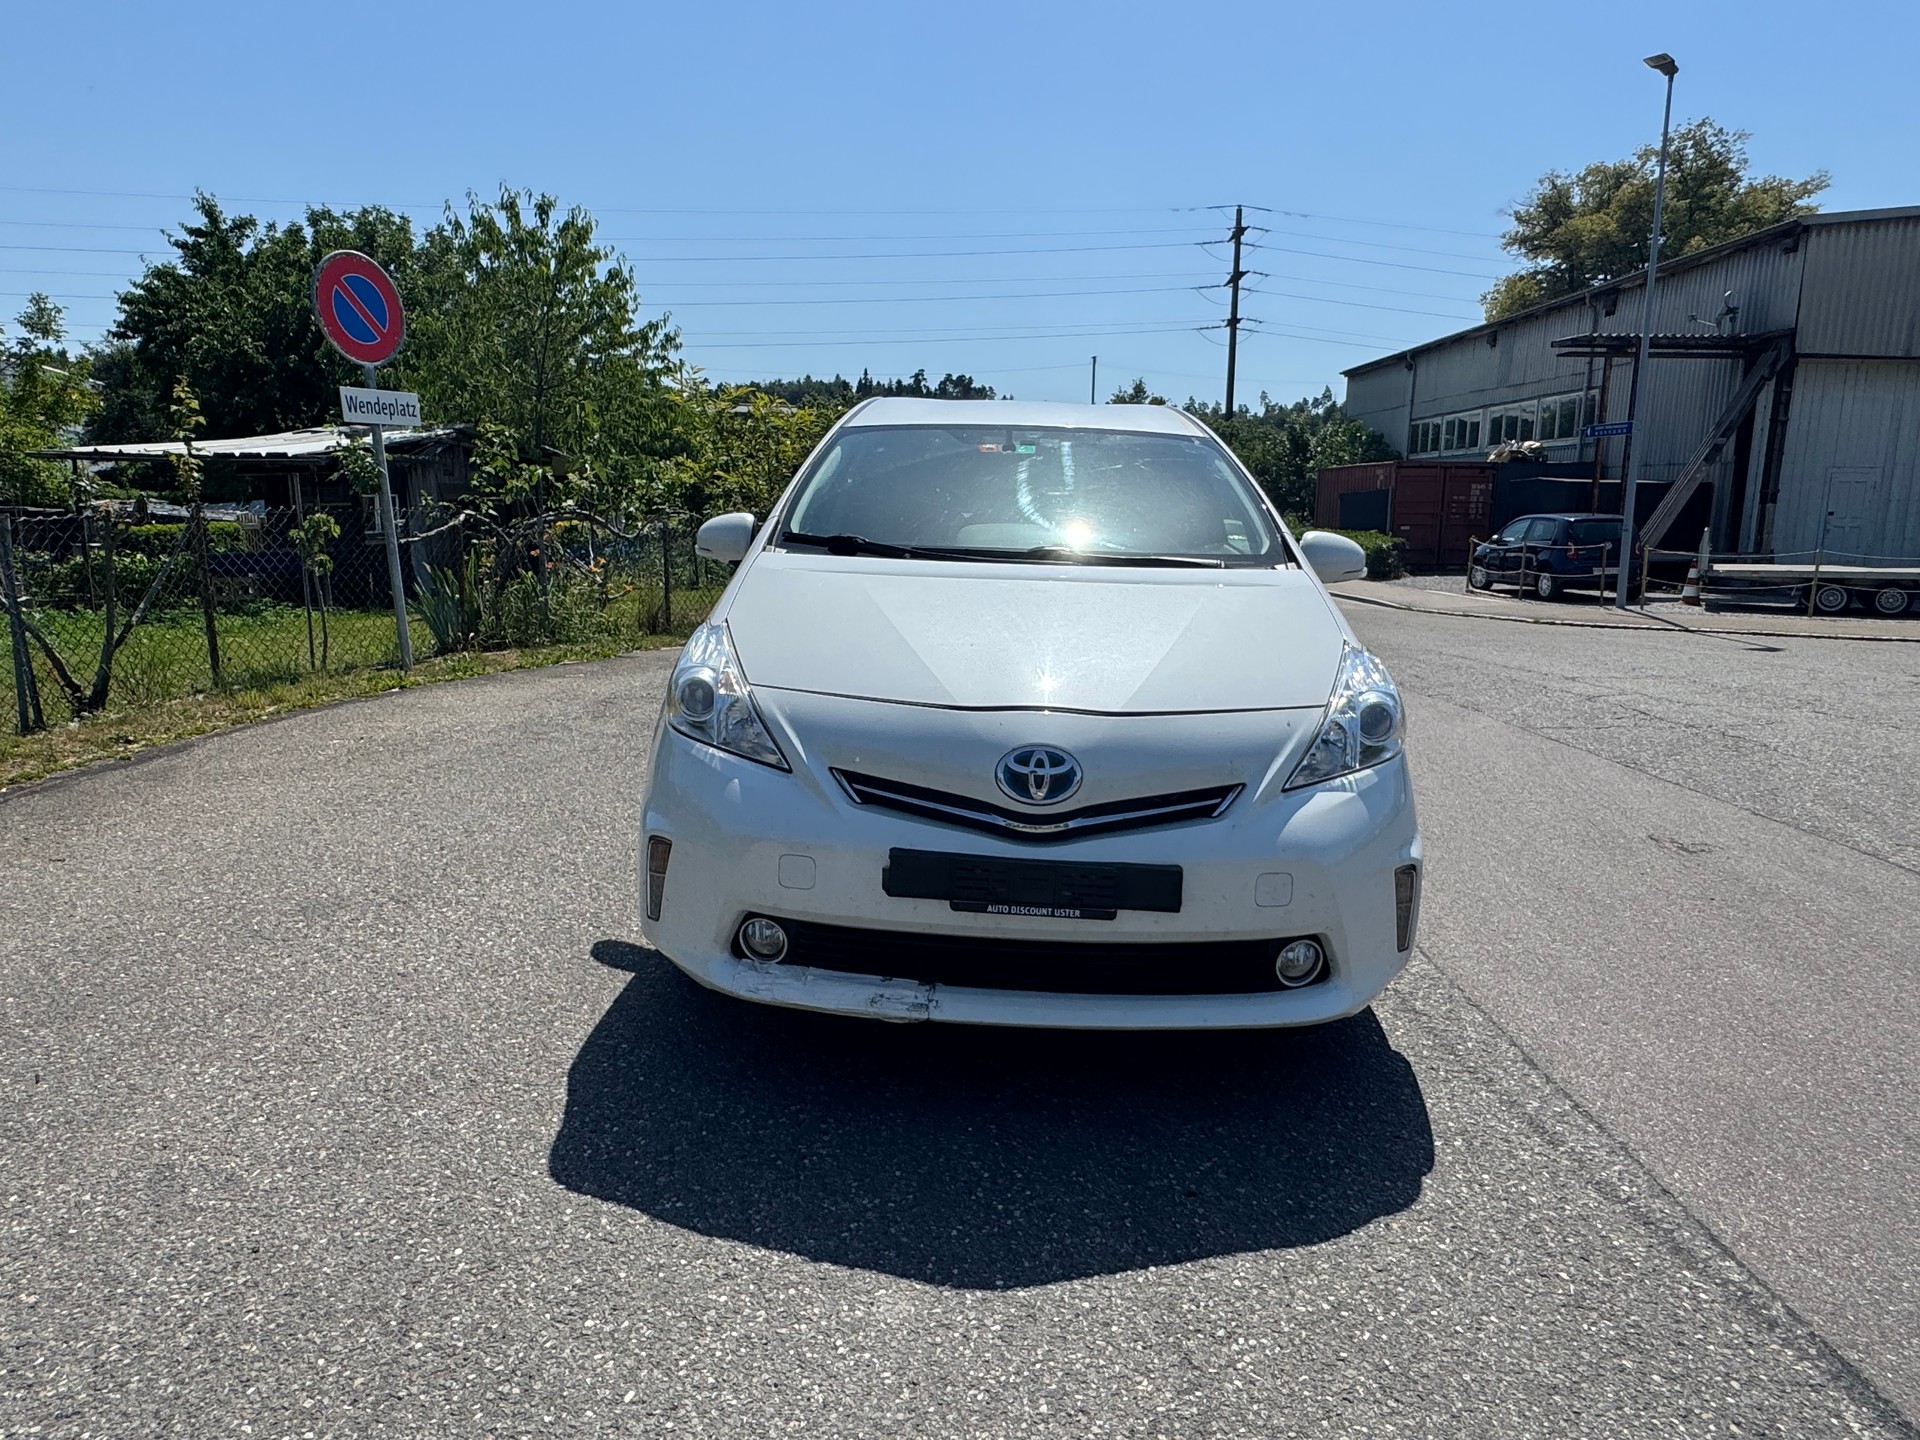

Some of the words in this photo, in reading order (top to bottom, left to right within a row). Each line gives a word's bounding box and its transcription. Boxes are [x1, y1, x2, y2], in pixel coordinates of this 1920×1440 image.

[344, 395, 417, 420] Wendeplatz
[987, 904, 1009, 913] AUTO
[1010, 905, 1053, 915] DISCOUNT
[1054, 908, 1080, 917] USTER
